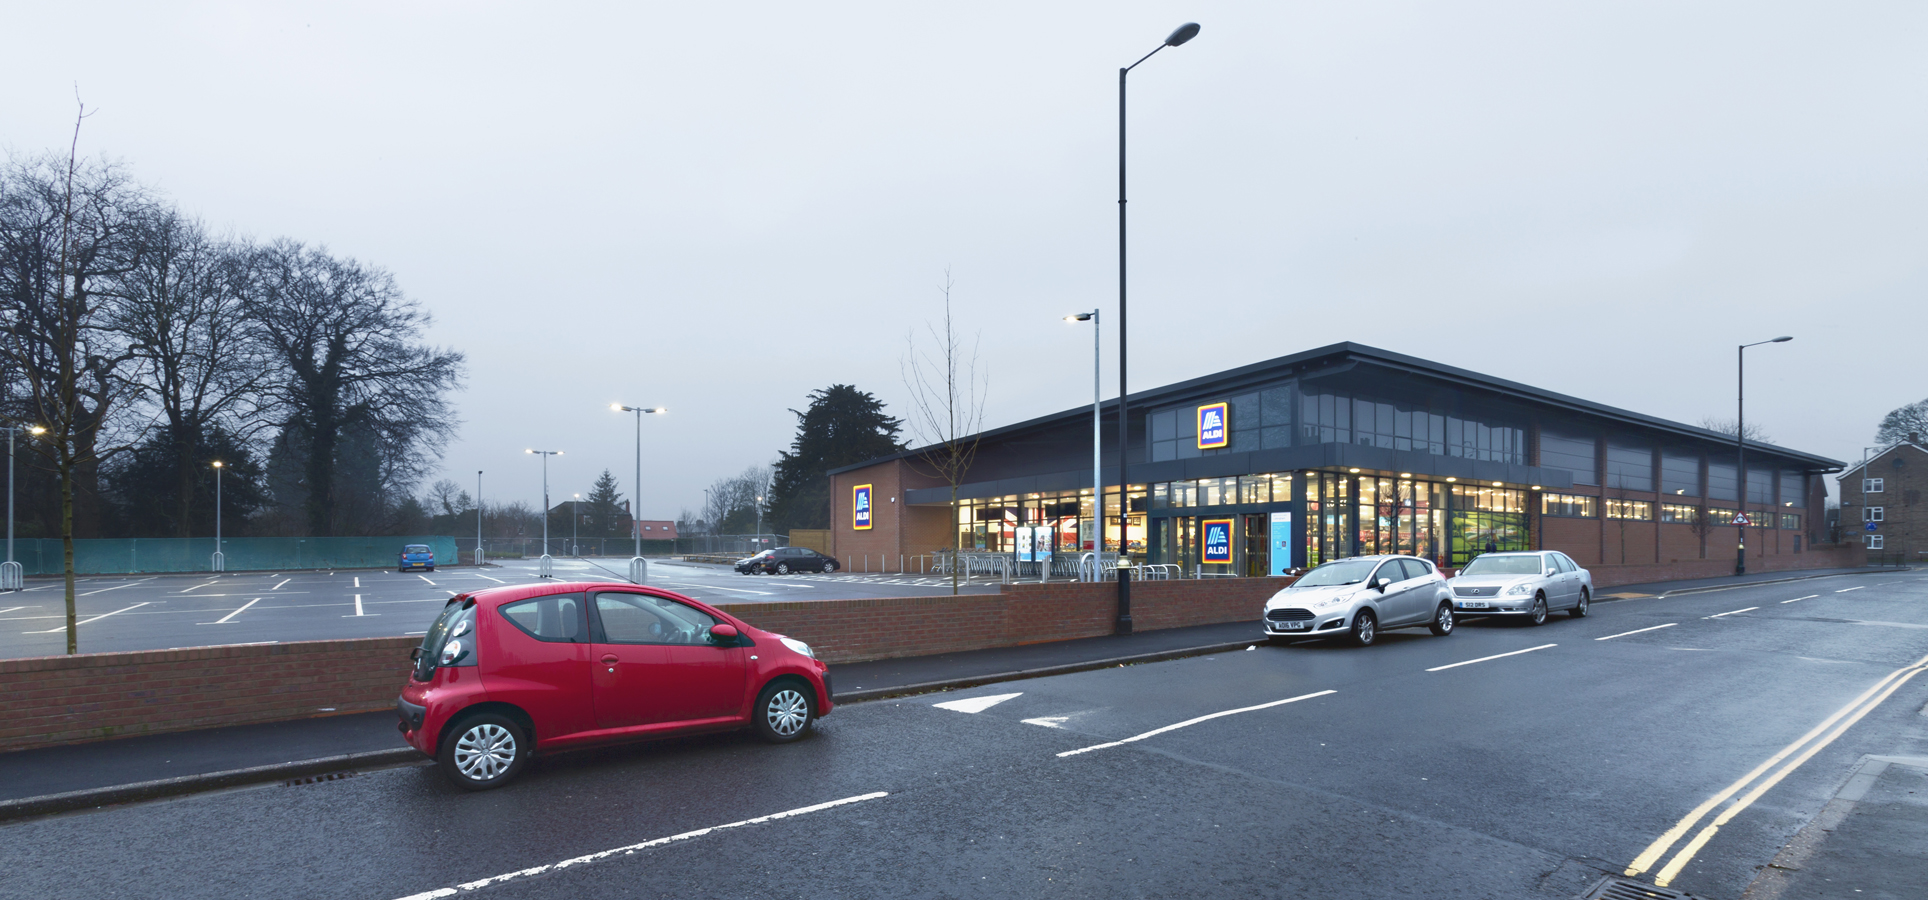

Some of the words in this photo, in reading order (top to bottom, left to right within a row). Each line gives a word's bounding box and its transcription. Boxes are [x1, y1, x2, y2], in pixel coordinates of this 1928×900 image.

[1202, 429, 1223, 440] ALDI
[856, 511, 870, 521] ALDI
[1207, 546, 1228, 555] ALDI
